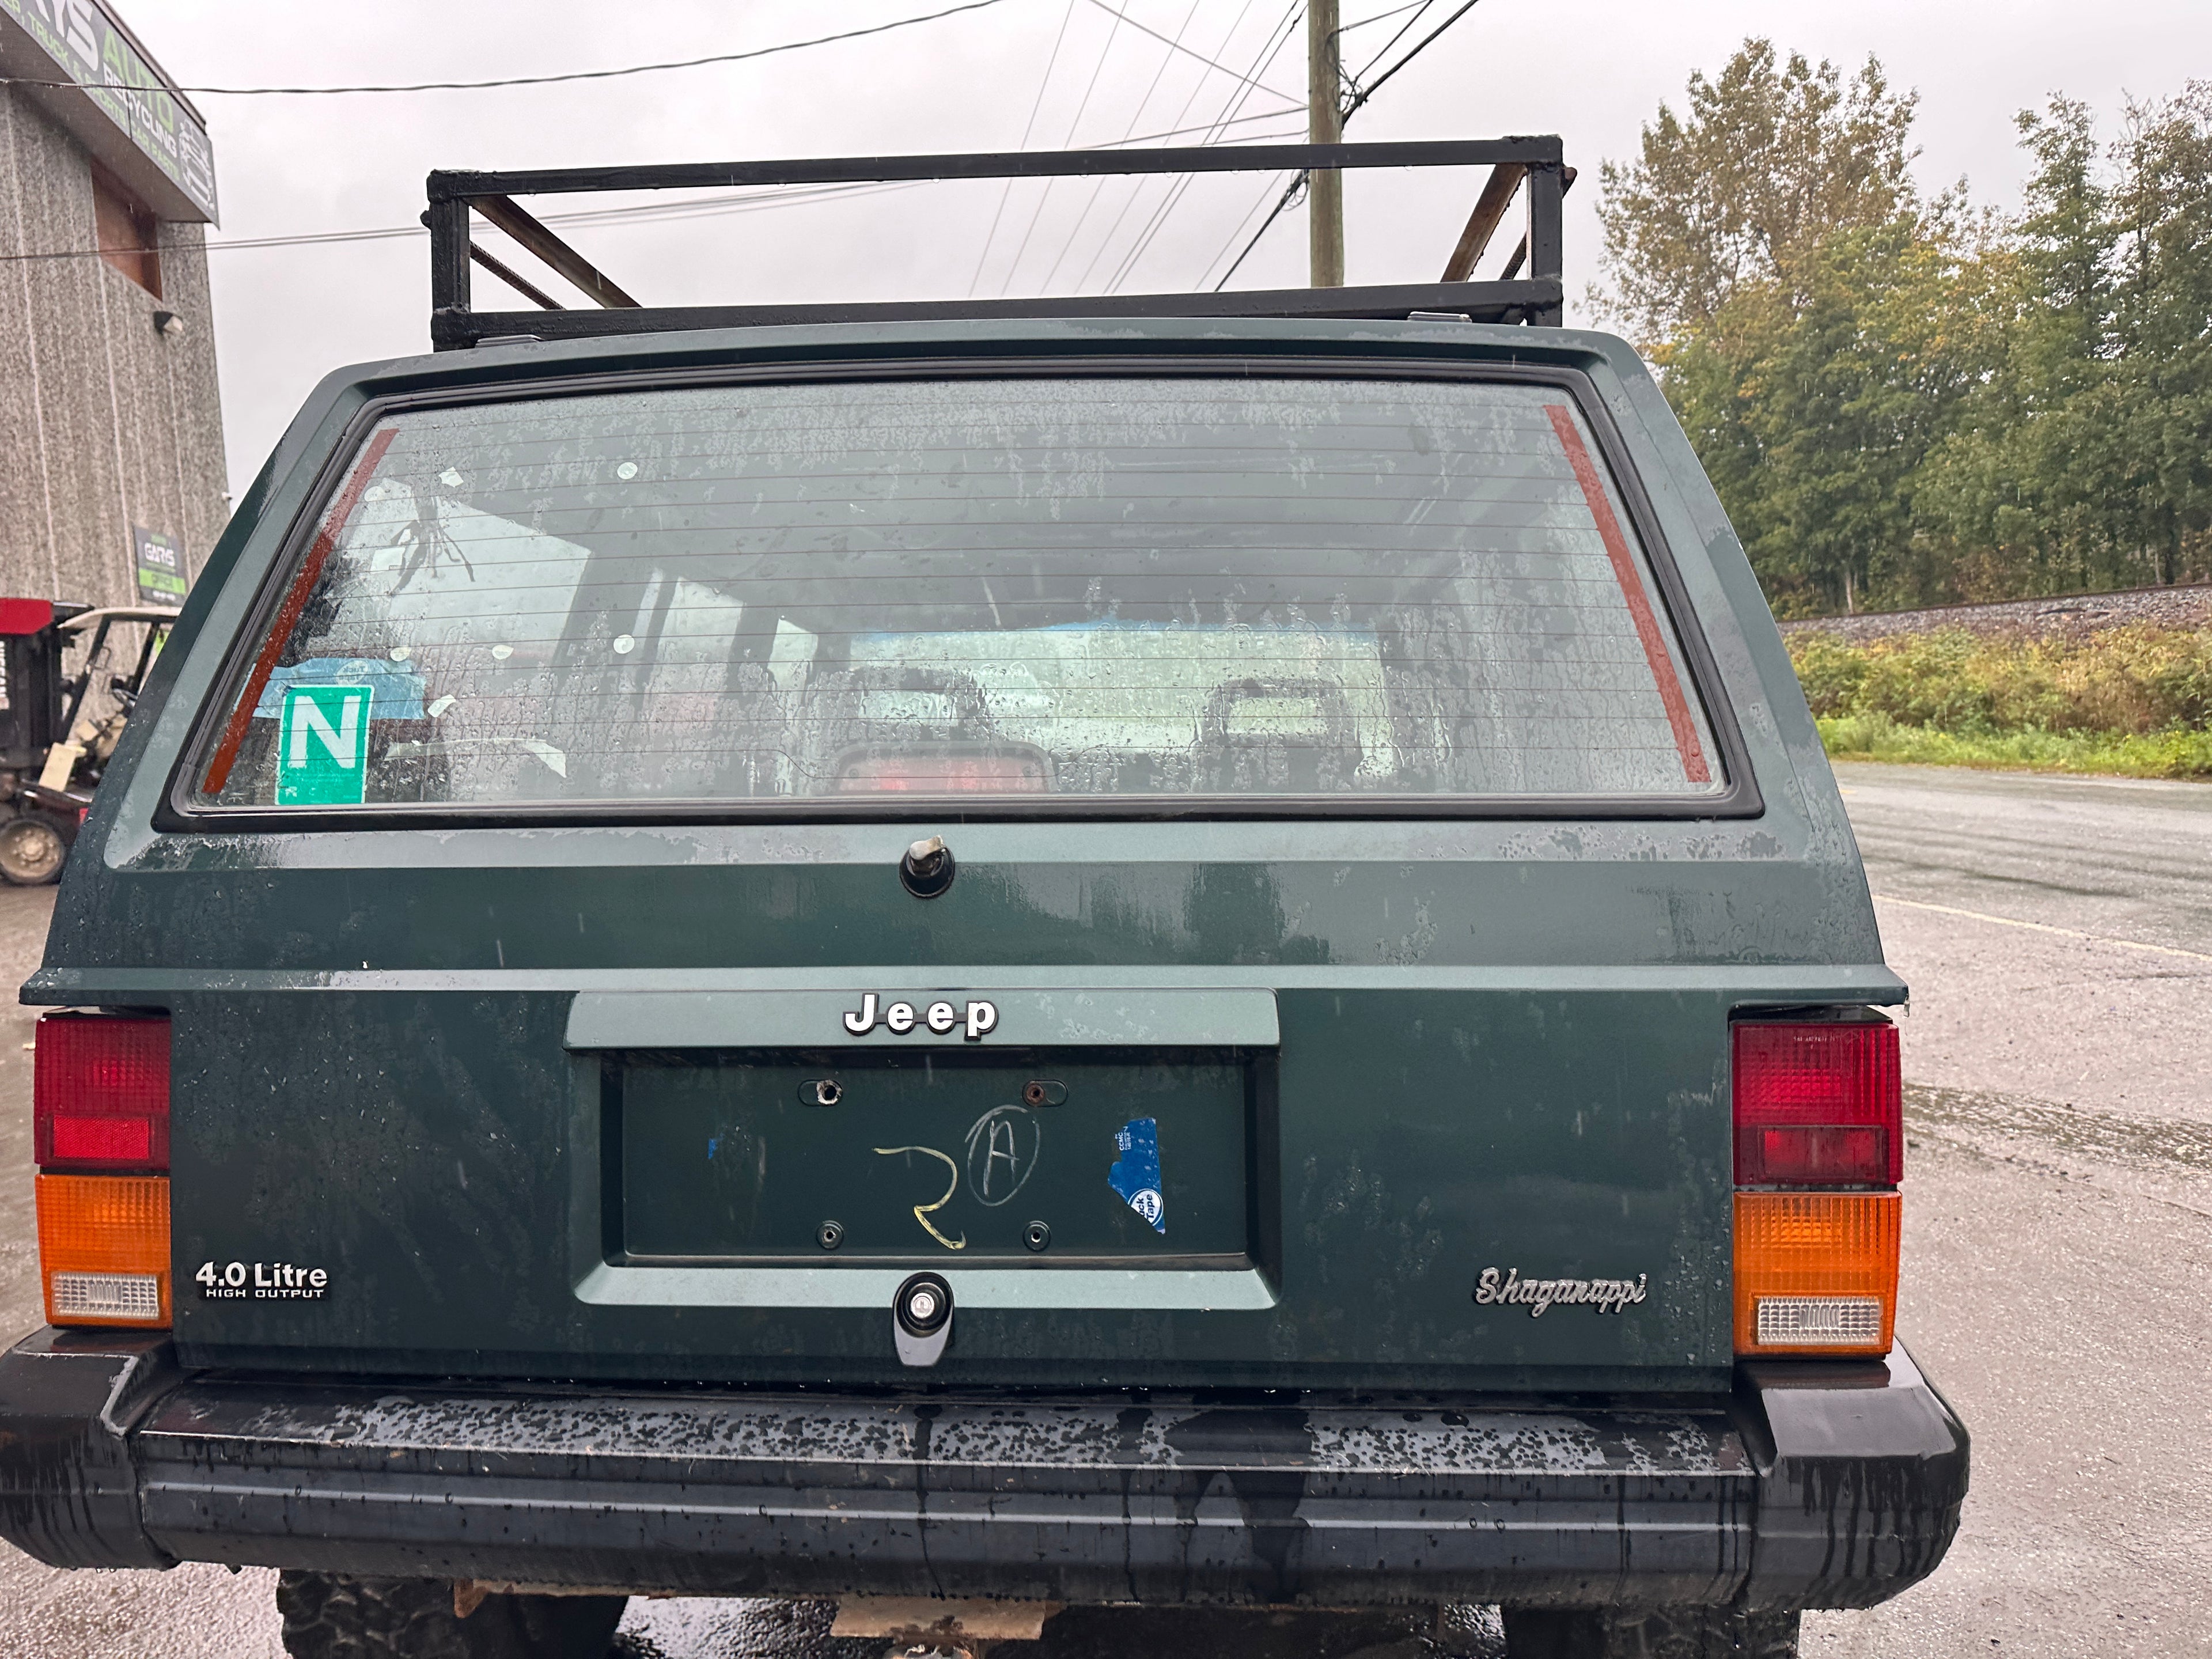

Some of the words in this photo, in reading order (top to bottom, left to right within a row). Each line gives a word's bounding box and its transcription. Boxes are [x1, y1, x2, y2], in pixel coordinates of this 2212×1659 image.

[27, 12, 70, 69] TRUCK
[103, 26, 174, 134] AUTO
[103, 62, 177, 158] RECYCLING
[287, 695, 362, 769] N
[843, 993, 998, 1040] Jeep
[1146, 1194, 1155, 1220] Tape
[195, 1261, 246, 1287] 4.0
[254, 1262, 327, 1287] Litre
[206, 1289, 247, 1298] HIGH
[255, 1289, 324, 1298] OUTPUT
[1475, 1267, 1647, 1318] Shaganappi
